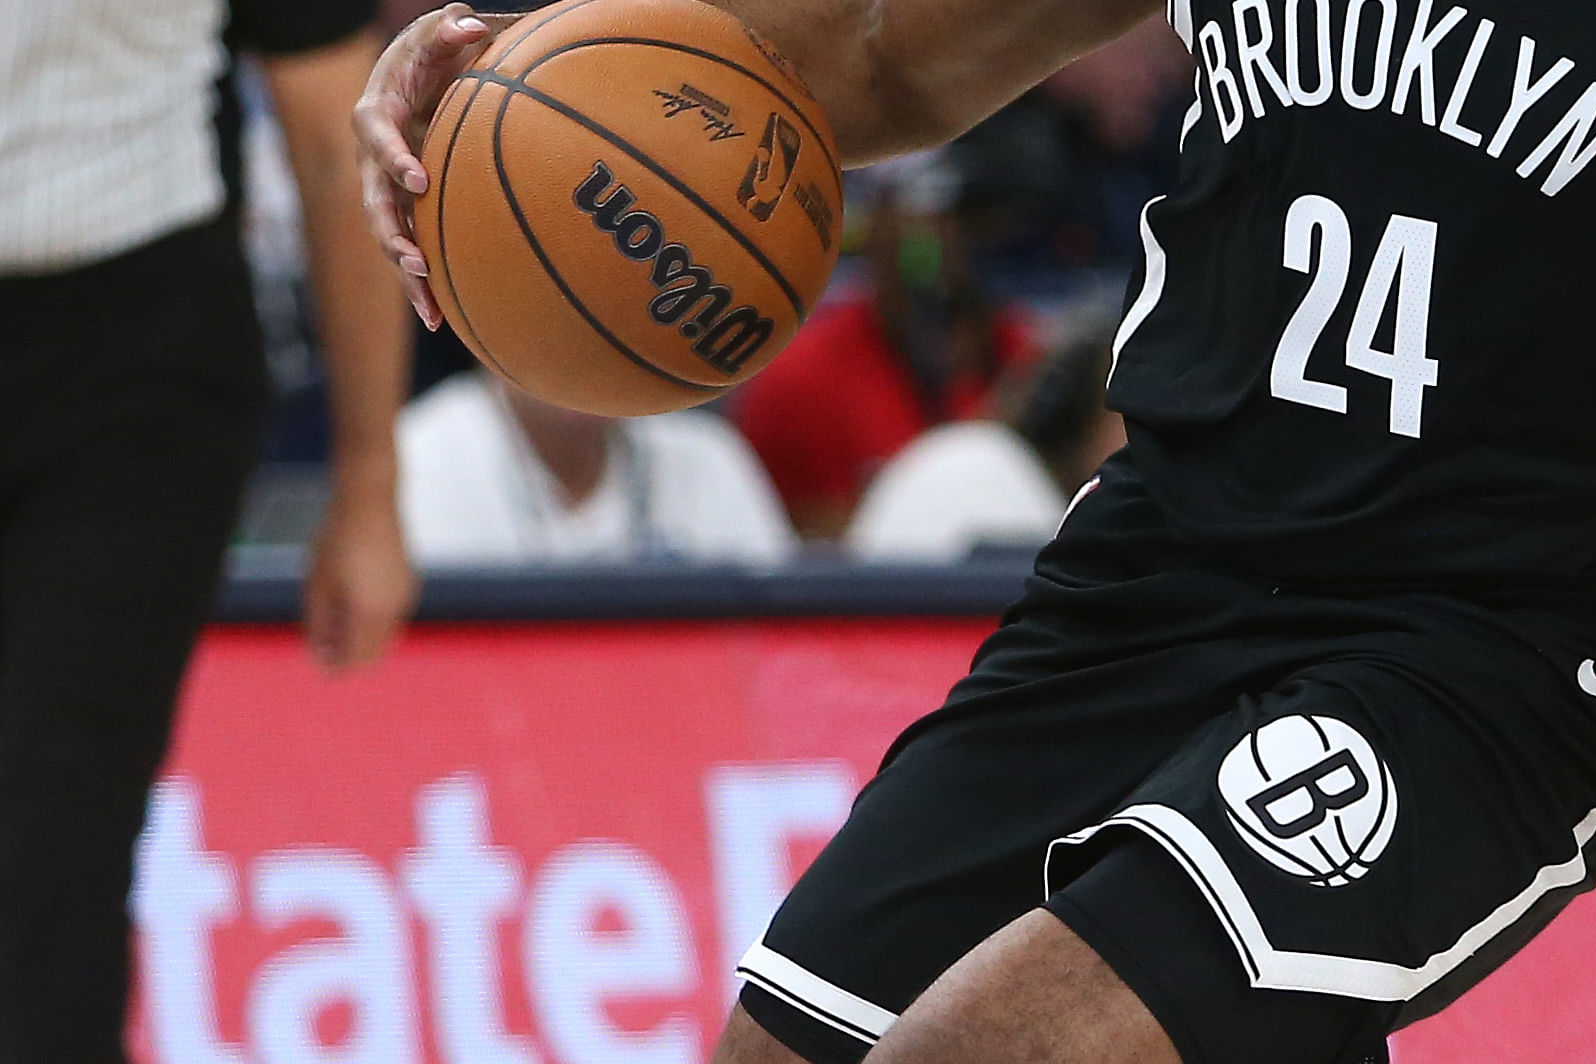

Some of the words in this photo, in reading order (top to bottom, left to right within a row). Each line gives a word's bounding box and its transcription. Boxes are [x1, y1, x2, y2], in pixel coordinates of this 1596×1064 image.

[573, 159, 776, 377] Wilson
[1270, 193, 1439, 439] 24
[128, 770, 702, 1064] tate
